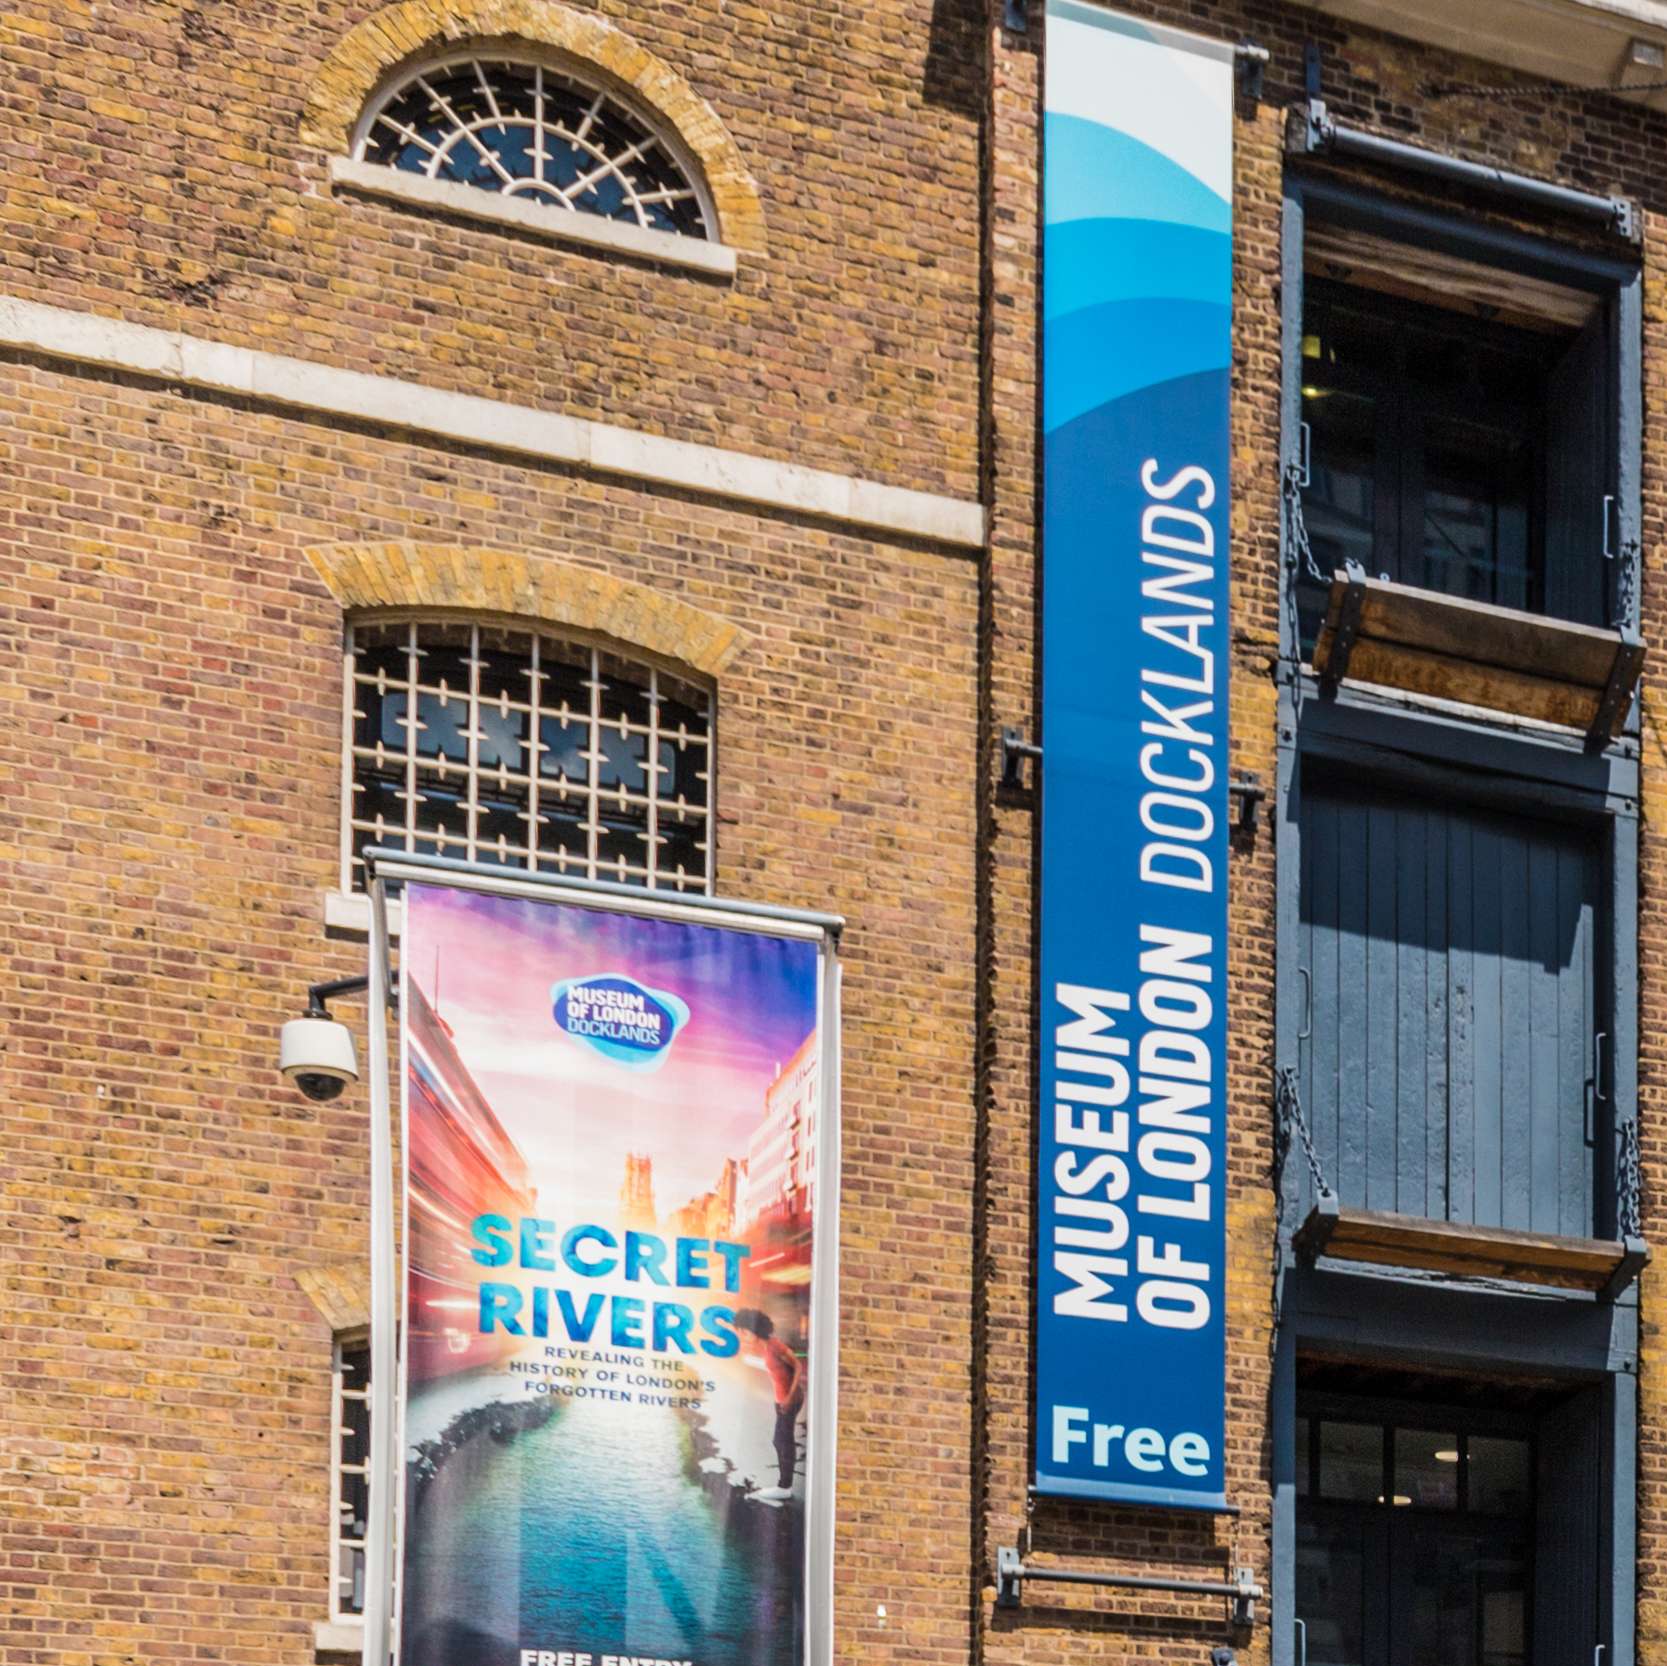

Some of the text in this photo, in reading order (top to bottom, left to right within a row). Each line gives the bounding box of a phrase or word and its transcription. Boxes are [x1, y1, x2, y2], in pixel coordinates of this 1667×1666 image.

[1137, 458, 1215, 1331] OF LONDON DOCKLANDS
[567, 984, 645, 1011] MUSEUM
[567, 1001, 661, 1030] OF LONDON
[567, 1017, 661, 1045] DOCKLANDS
[1054, 982, 1130, 1323] MUSEUM
[470, 1213, 751, 1294] SECRET
[477, 1281, 741, 1359] RIVERS
[544, 1346, 684, 1373] REVEALING THE
[509, 1361, 716, 1392] HISTORY OF LONDON'S
[524, 1380, 702, 1410] FORGOTTEN RIVERS
[1051, 1404, 1211, 1477] Free
